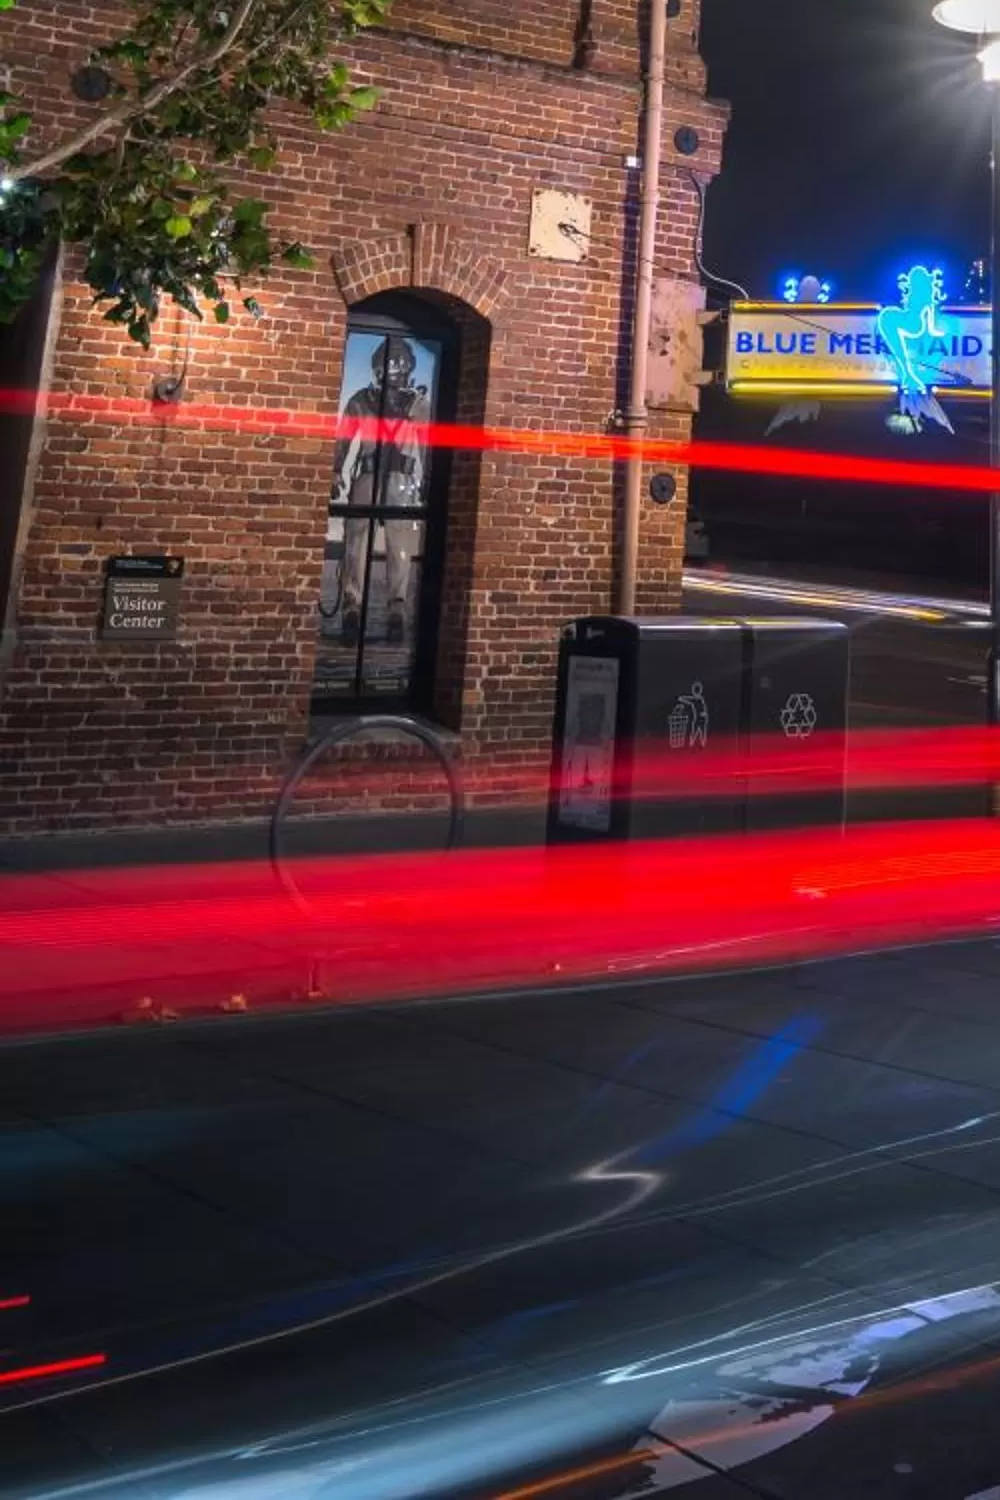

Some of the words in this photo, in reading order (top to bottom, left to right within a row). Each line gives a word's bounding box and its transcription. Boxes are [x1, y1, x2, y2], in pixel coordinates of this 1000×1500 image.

[736, 331, 815, 354] BLUE
[828, 333, 983, 357] MERAID
[112, 595, 168, 611] Visitor
[109, 613, 167, 629] Center
